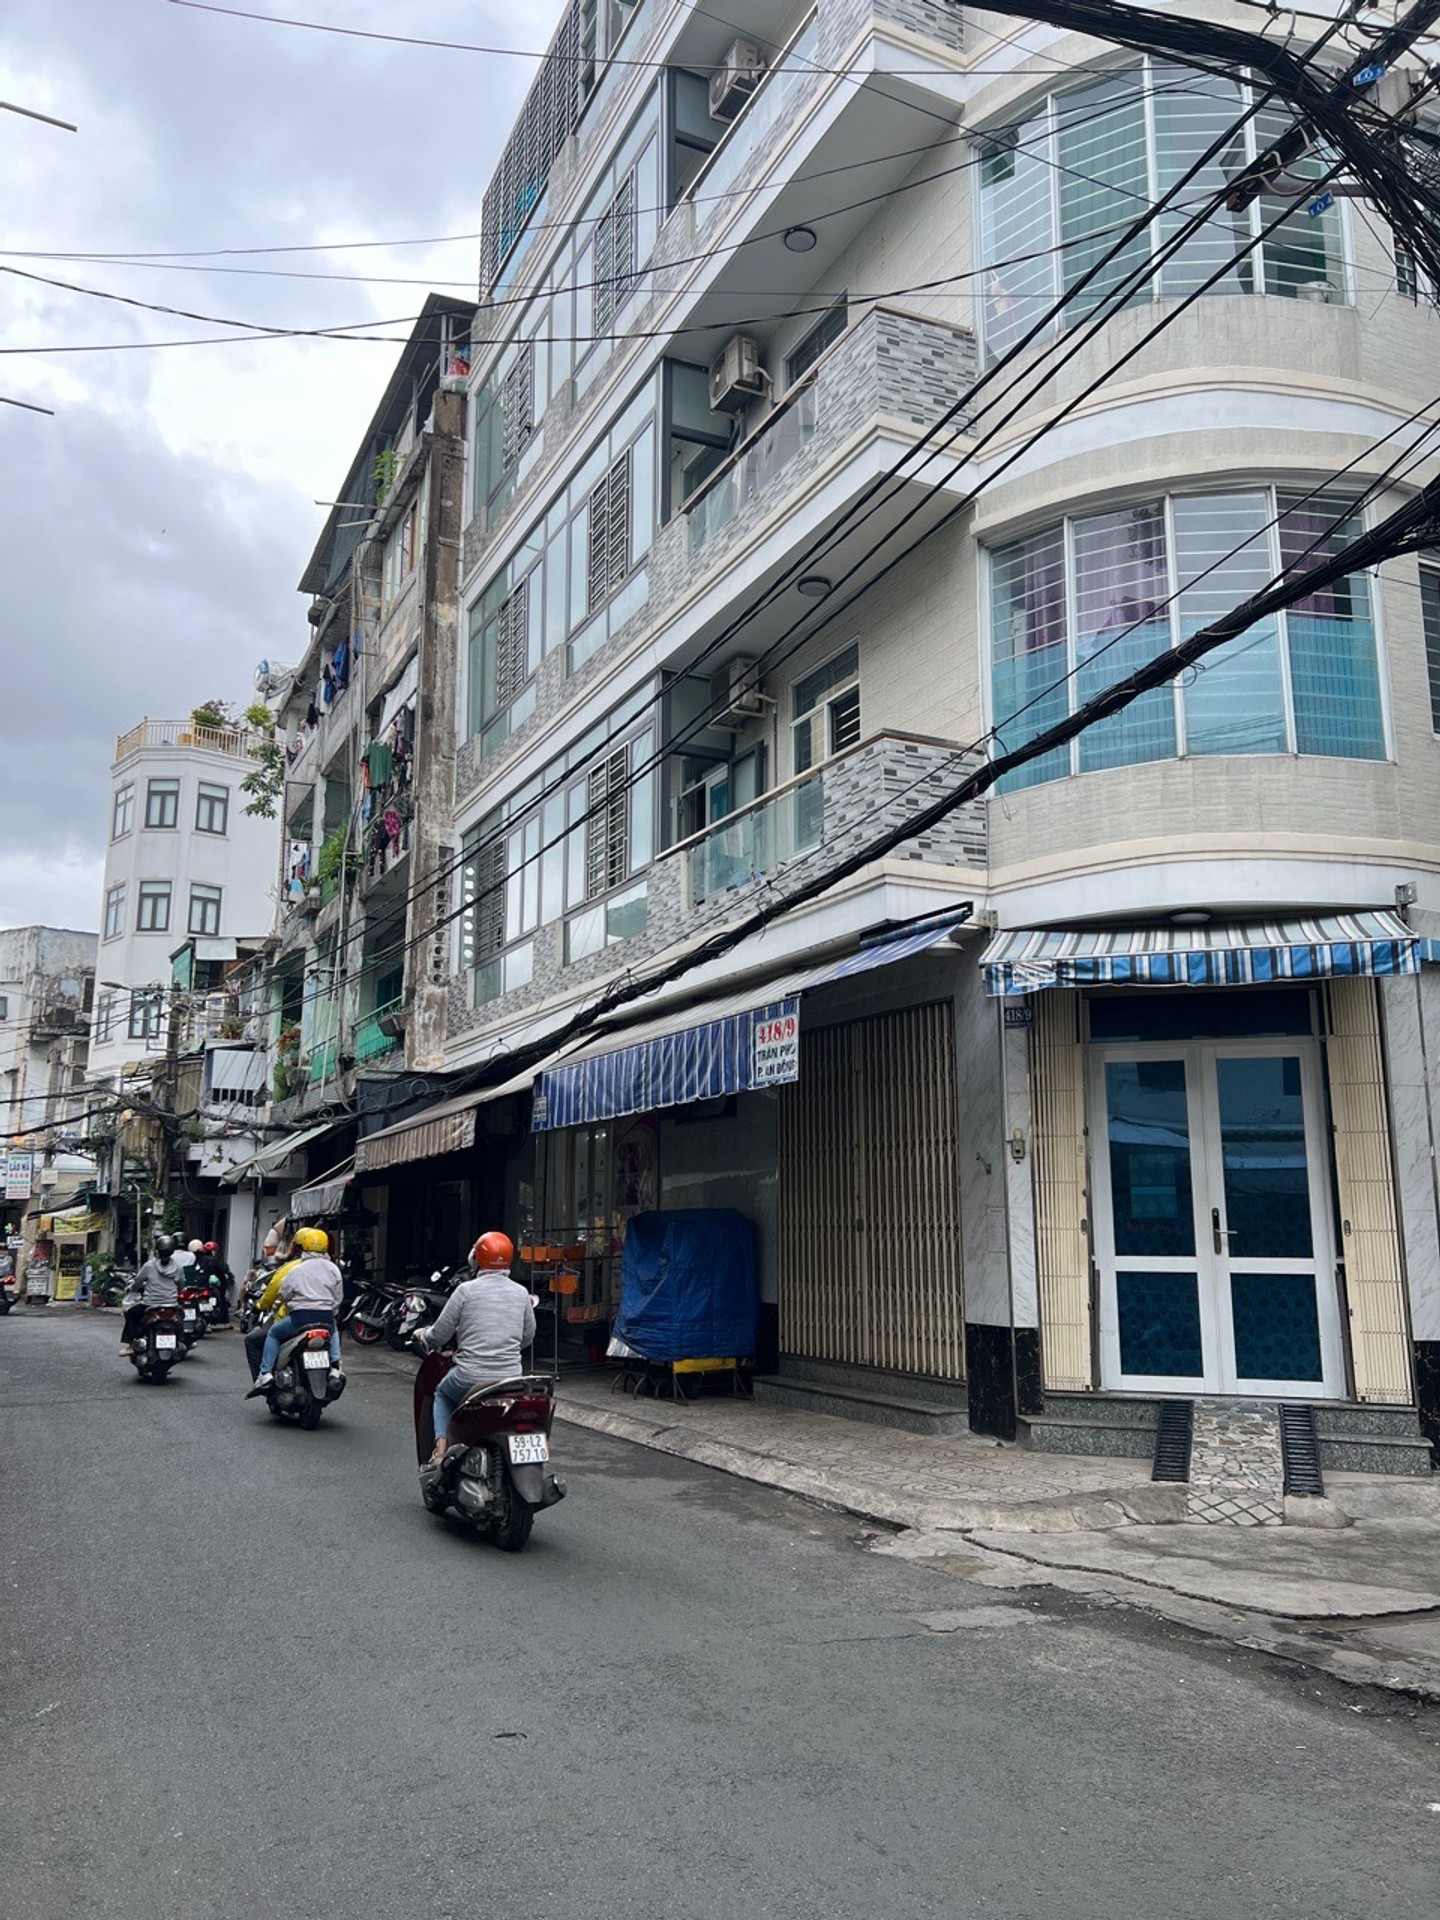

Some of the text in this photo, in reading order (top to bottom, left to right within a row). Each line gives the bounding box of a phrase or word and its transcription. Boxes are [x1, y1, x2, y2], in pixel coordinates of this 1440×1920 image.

[1005, 1008, 1032, 1021] 418/9
[758, 1017, 795, 1044] 418/9
[512, 1448, 547, 1462] 757.10
